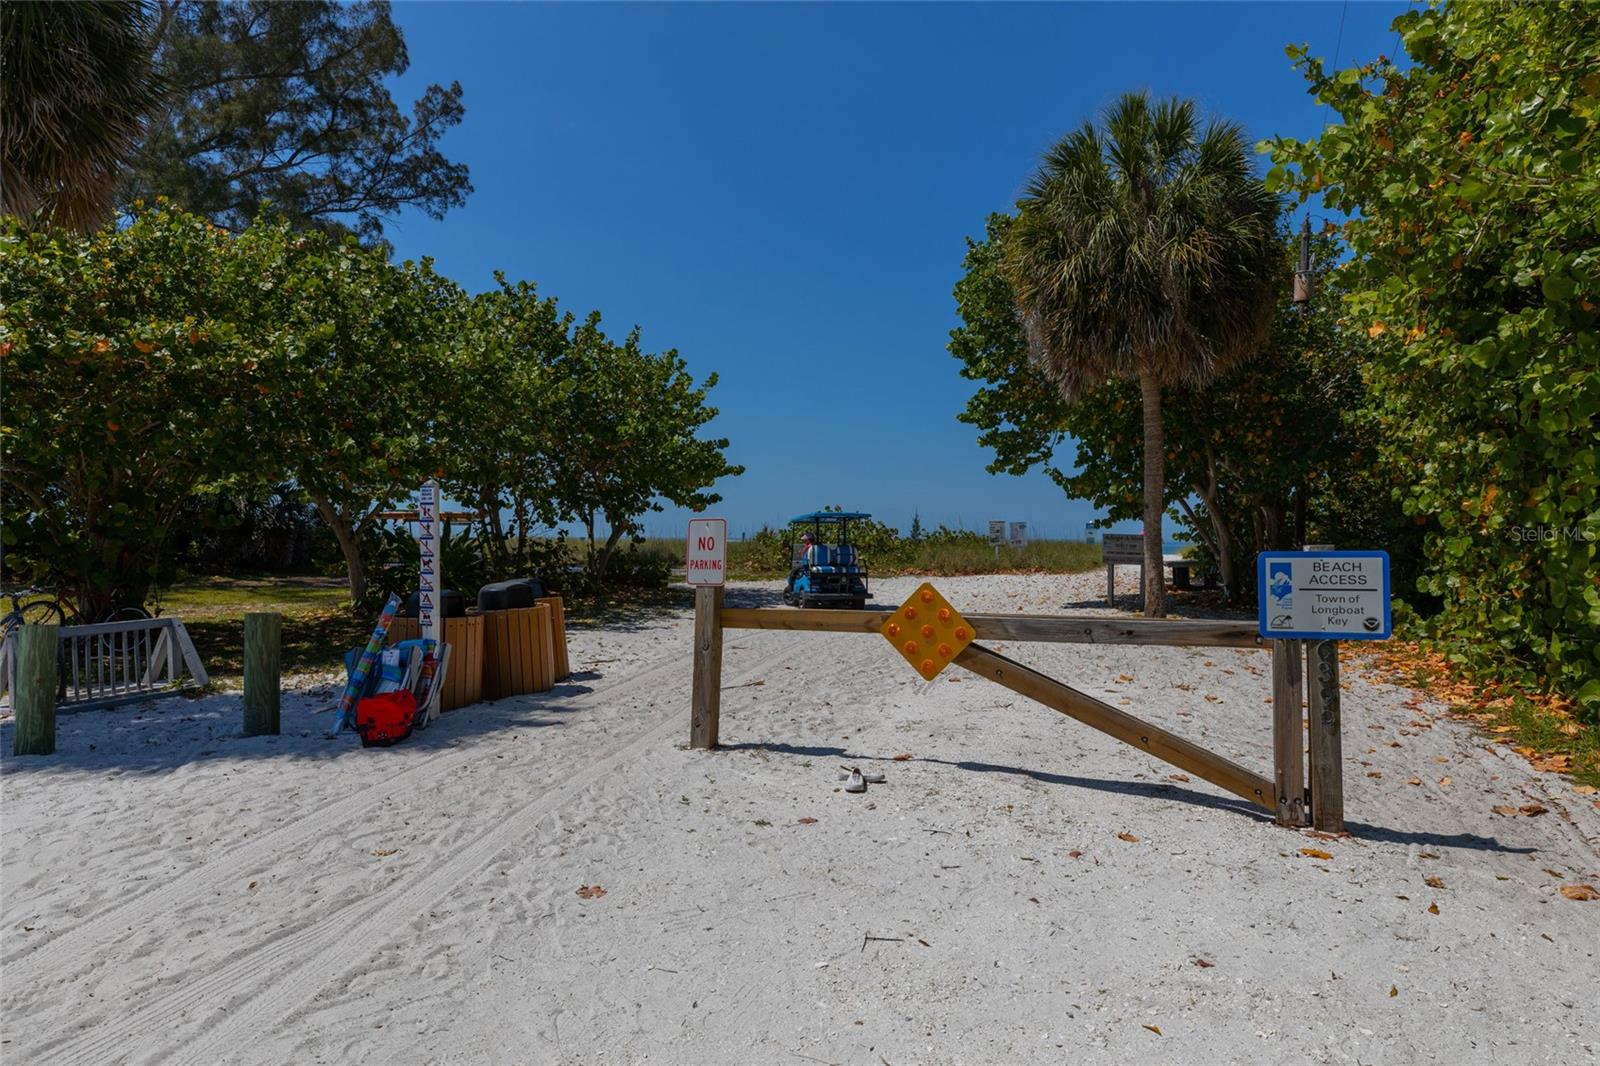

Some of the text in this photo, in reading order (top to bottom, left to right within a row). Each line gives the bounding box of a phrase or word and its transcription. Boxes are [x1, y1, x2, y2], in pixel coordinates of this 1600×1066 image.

[698, 536, 715, 550] NO
[690, 559, 722, 570] PARKING
[1312, 561, 1362, 572] BEACH
[1308, 574, 1368, 586] ACCESS
[1315, 593, 1361, 604] Town of
[1311, 605, 1365, 616] Longboat
[1327, 616, 1349, 627] Key
